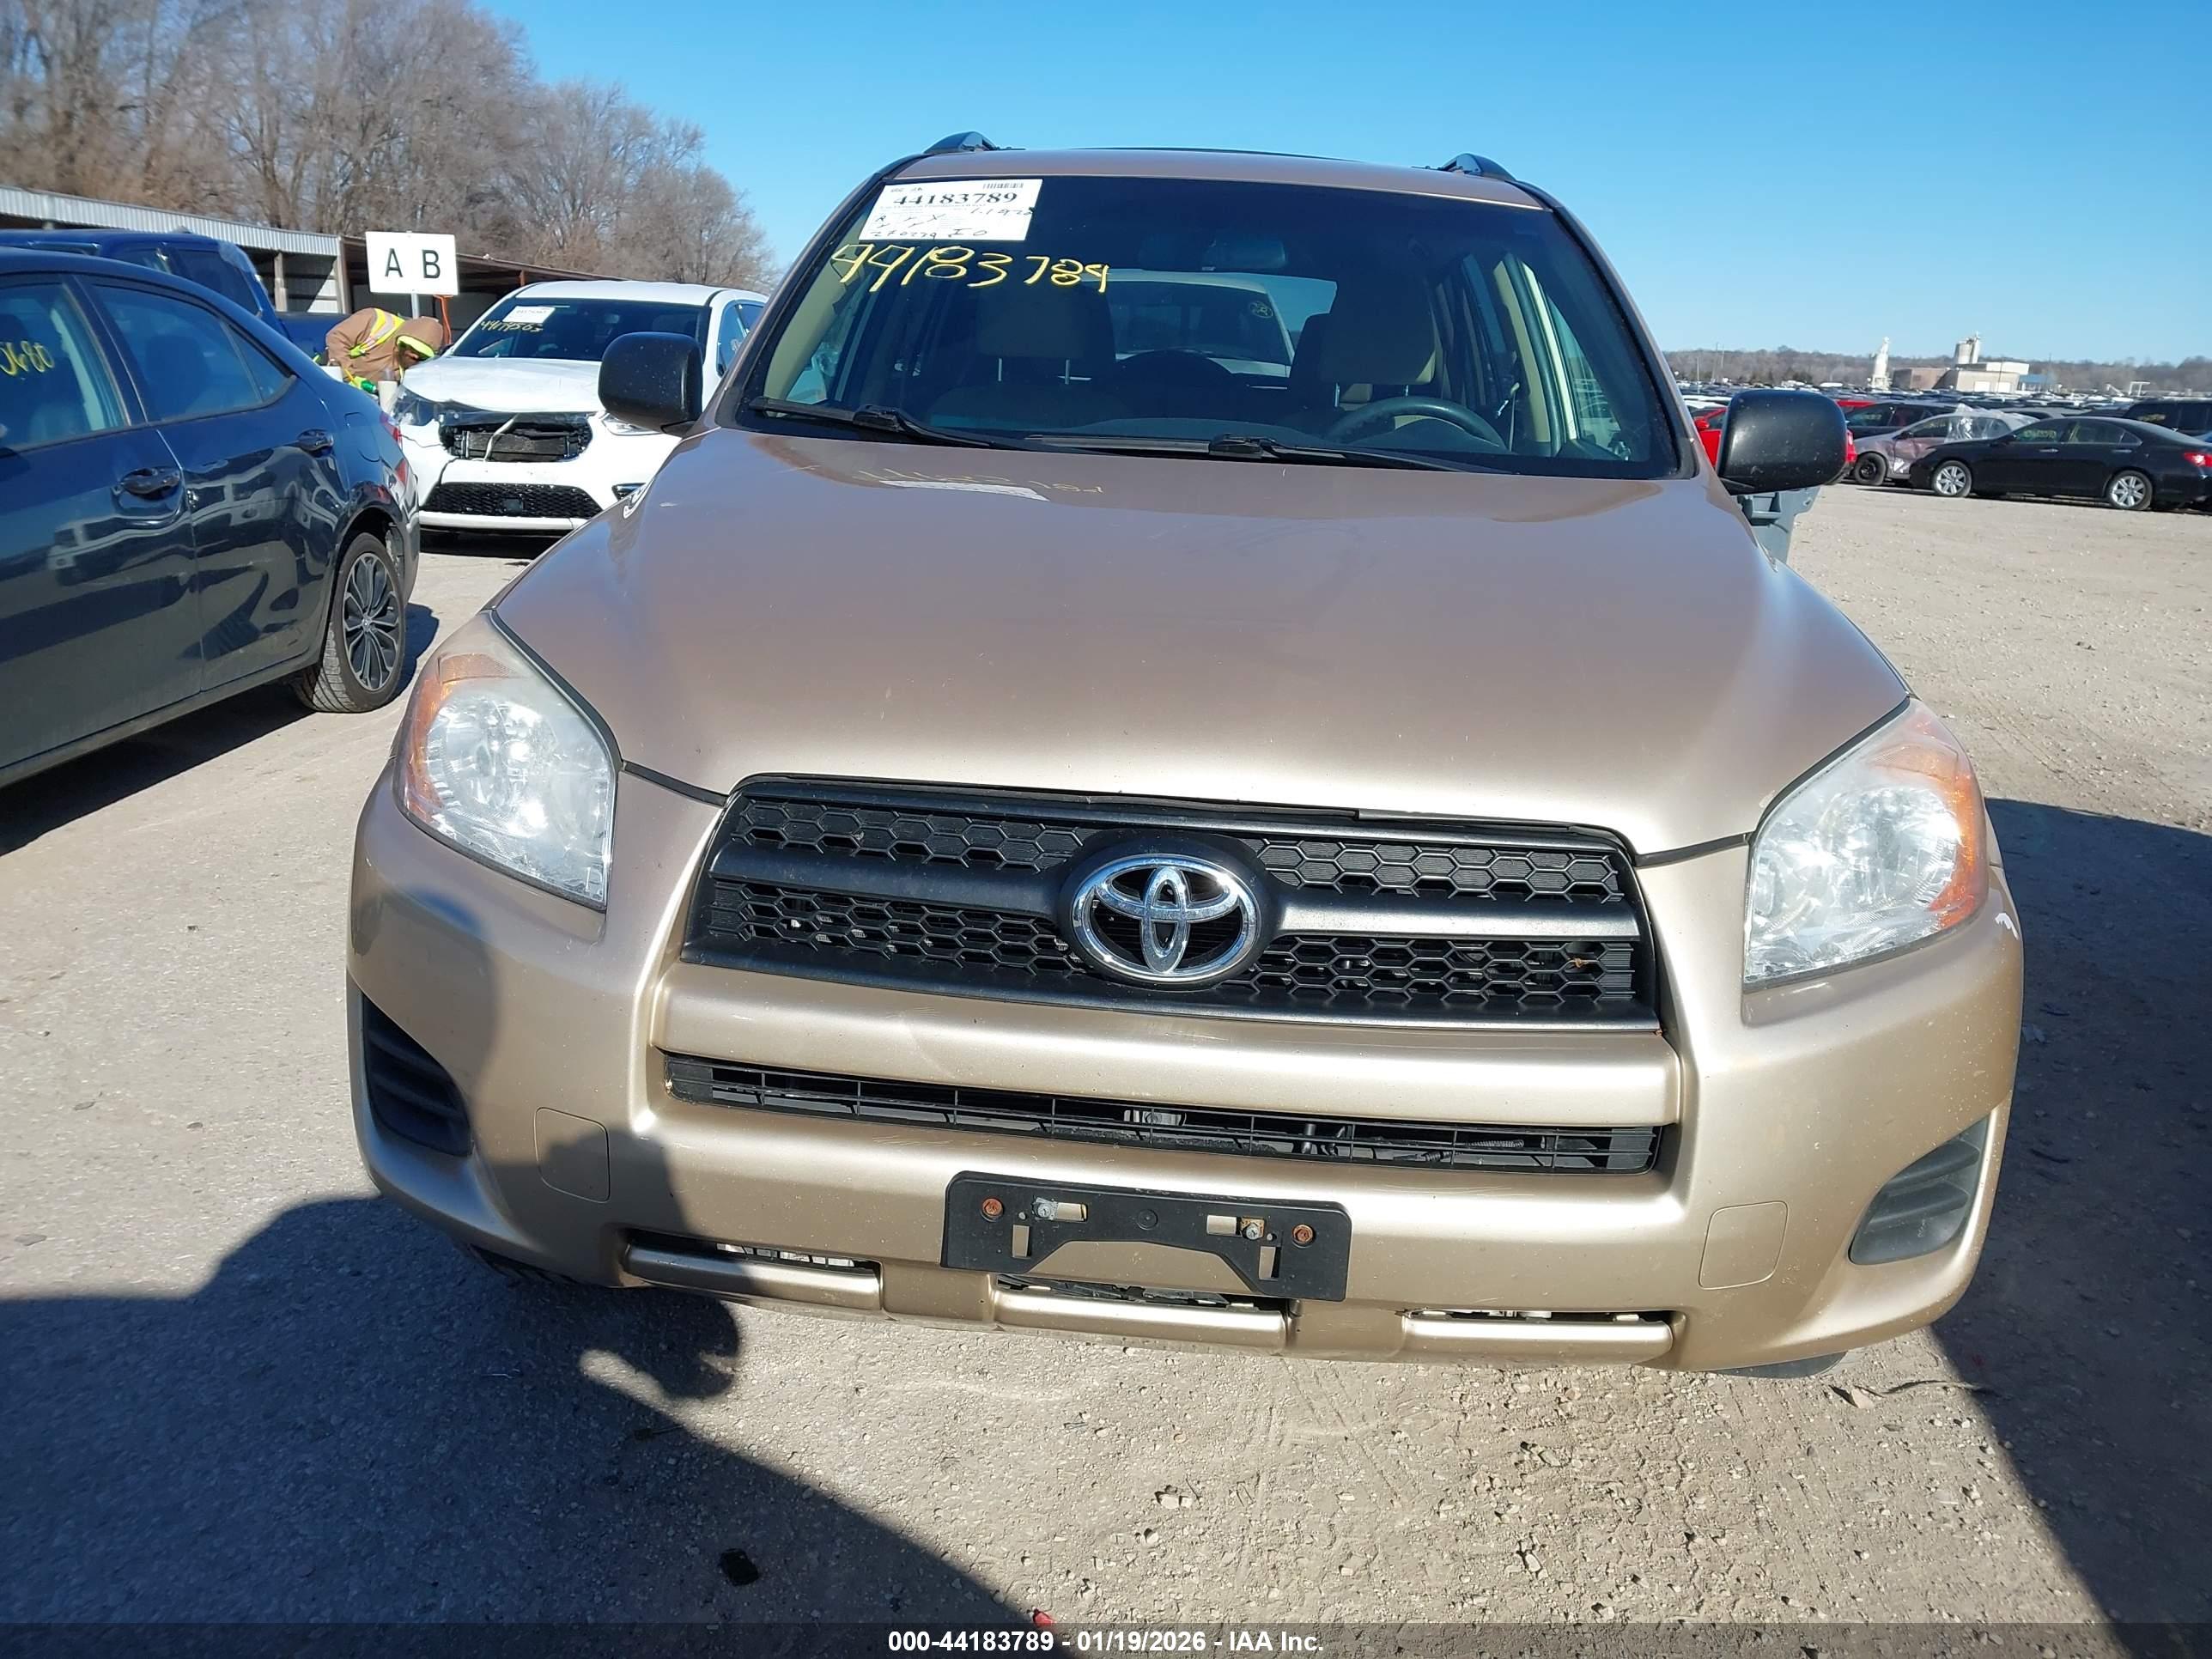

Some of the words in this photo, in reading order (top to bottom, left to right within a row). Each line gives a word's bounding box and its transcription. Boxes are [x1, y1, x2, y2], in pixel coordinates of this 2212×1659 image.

[893, 192, 1018, 204] 44183789
[385, 248, 404, 277] A
[422, 249, 441, 279] B
[831, 243, 1109, 293] 44183789
